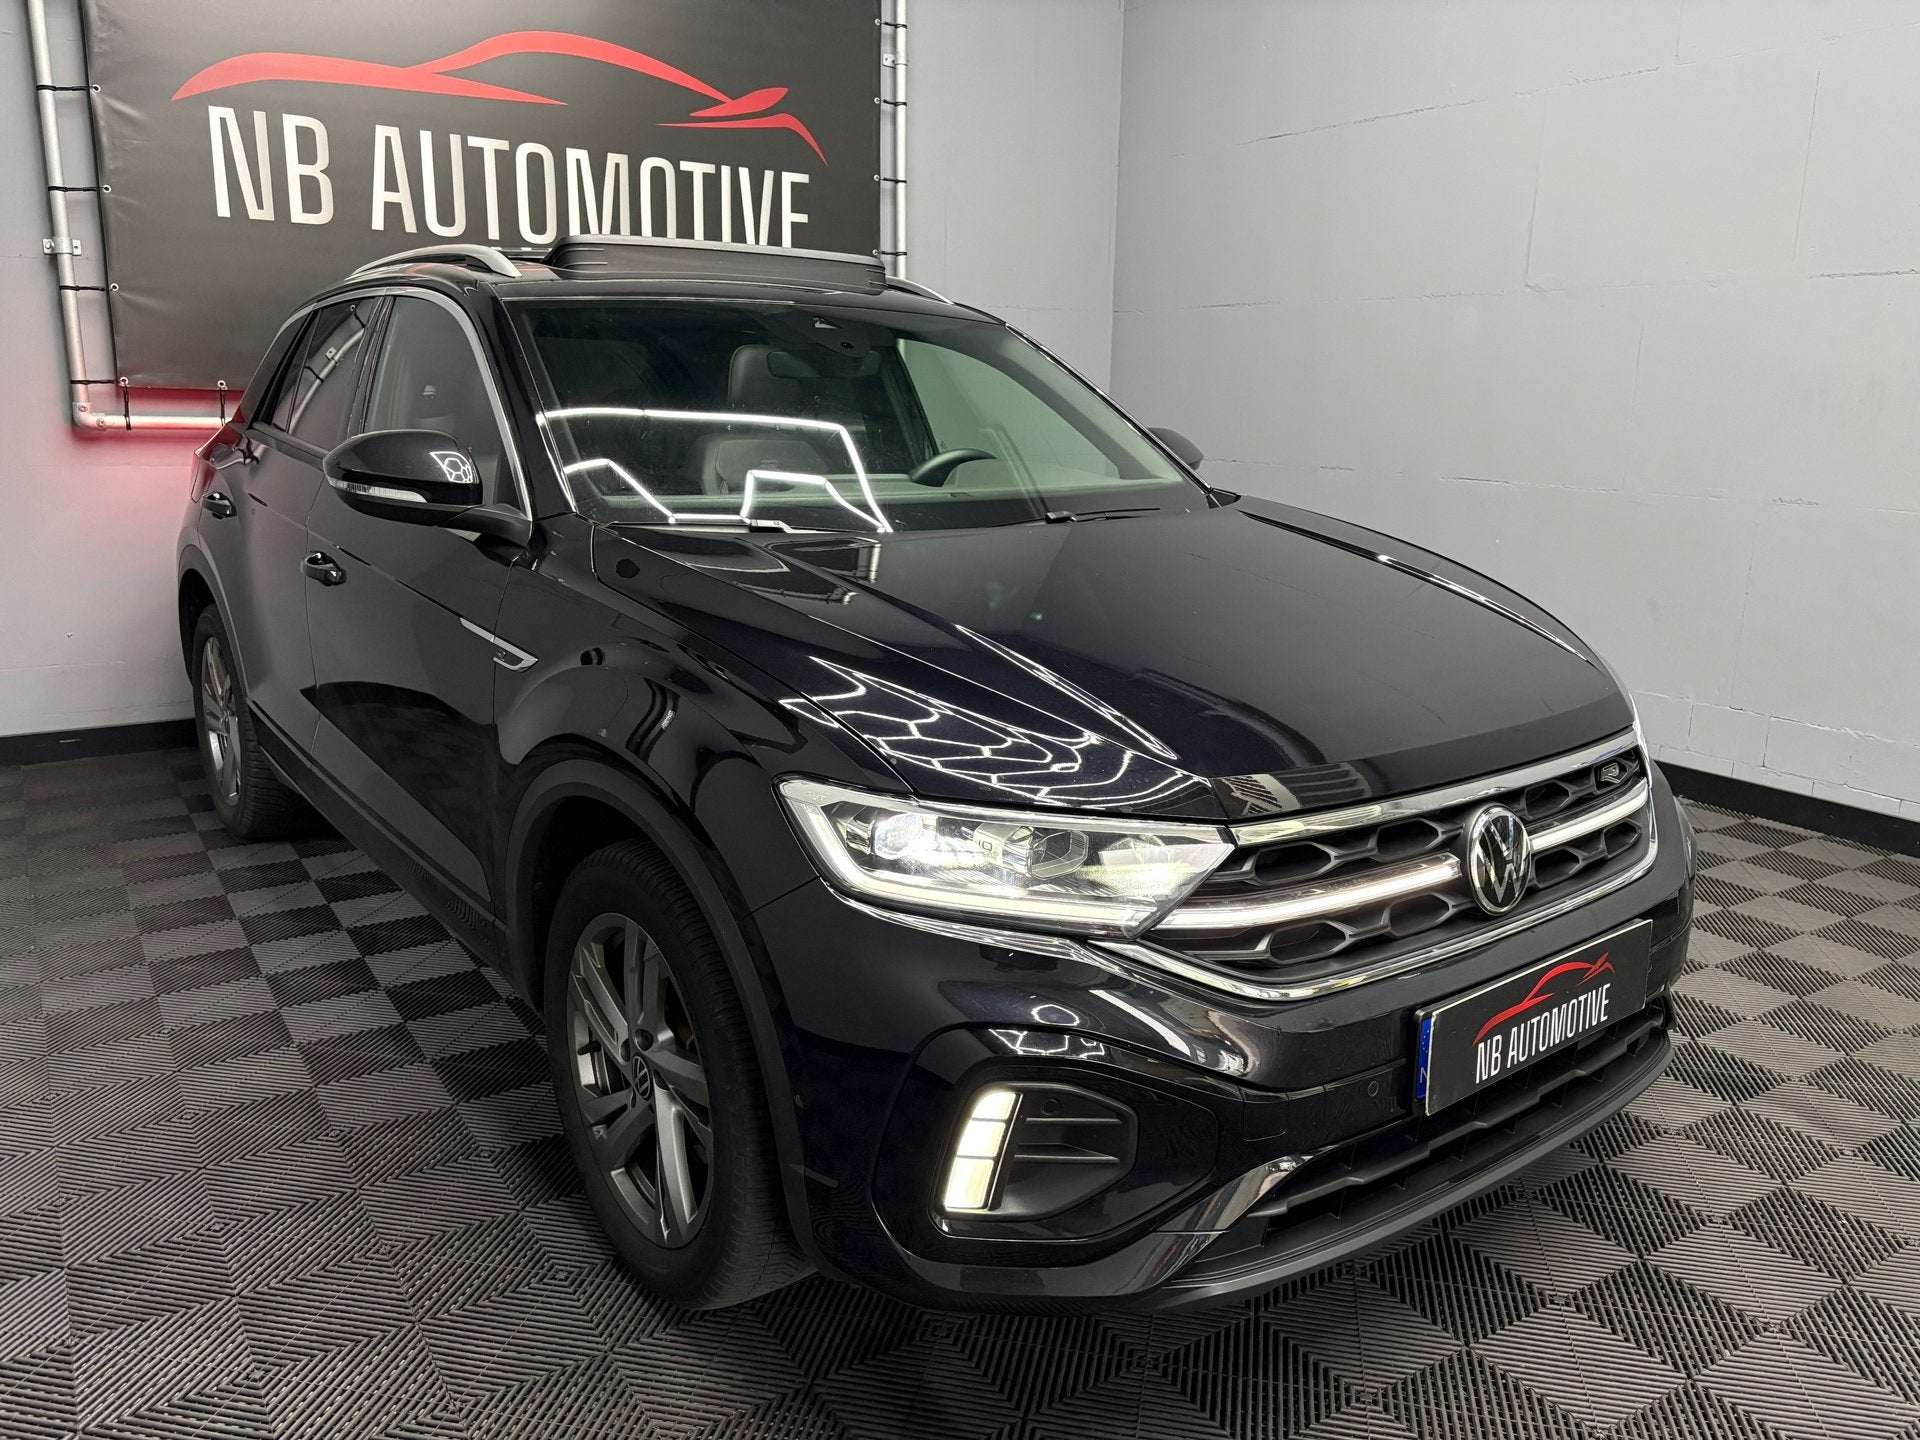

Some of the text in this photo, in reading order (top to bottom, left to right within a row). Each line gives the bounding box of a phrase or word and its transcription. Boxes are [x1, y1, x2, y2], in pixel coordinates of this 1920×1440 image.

[207, 105, 810, 248] NB AUTOMOTIVE
[1475, 983, 1611, 1084] NB AUTOMOTIVE
